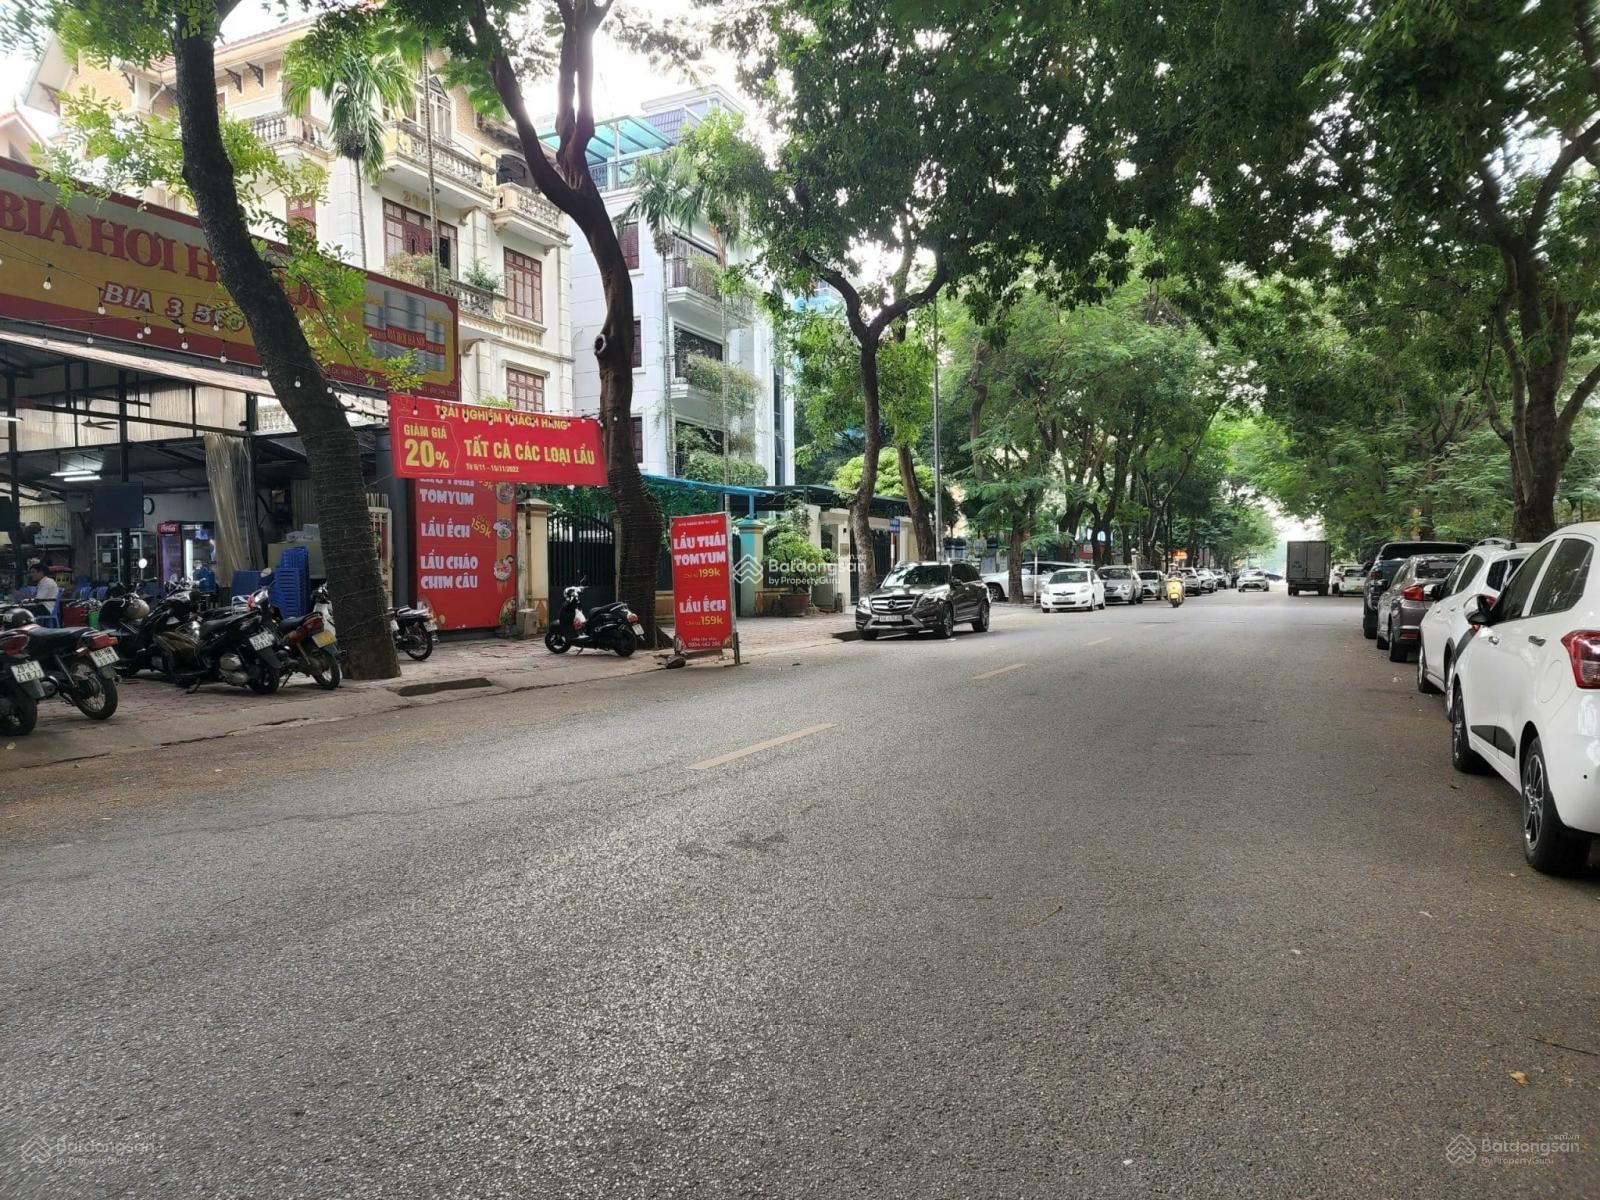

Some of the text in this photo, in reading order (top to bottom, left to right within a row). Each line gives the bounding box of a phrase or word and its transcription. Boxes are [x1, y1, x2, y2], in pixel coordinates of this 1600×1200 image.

[0, 189, 83, 249] BIA
[86, 214, 178, 274] HƠI
[103, 281, 153, 313] BIA
[165, 297, 184, 320] 3
[403, 422, 448, 440] GIẢM GIÁ
[404, 438, 449, 469] 20%
[463, 434, 595, 466] TẤT CẢ CÁC LOẠI LẨU
[419, 488, 475, 506] TOMYUM
[421, 516, 445, 538] LẨU
[673, 532, 726, 551] LẨU THÁI
[420, 549, 479, 571] LẨU CHÁO
[673, 551, 727, 566] TOMYUM
[421, 572, 479, 589] CHIM CÂU
[698, 568, 721, 578] 199k
[679, 595, 727, 614] LẨU ẾCH
[700, 615, 724, 626] 159k
